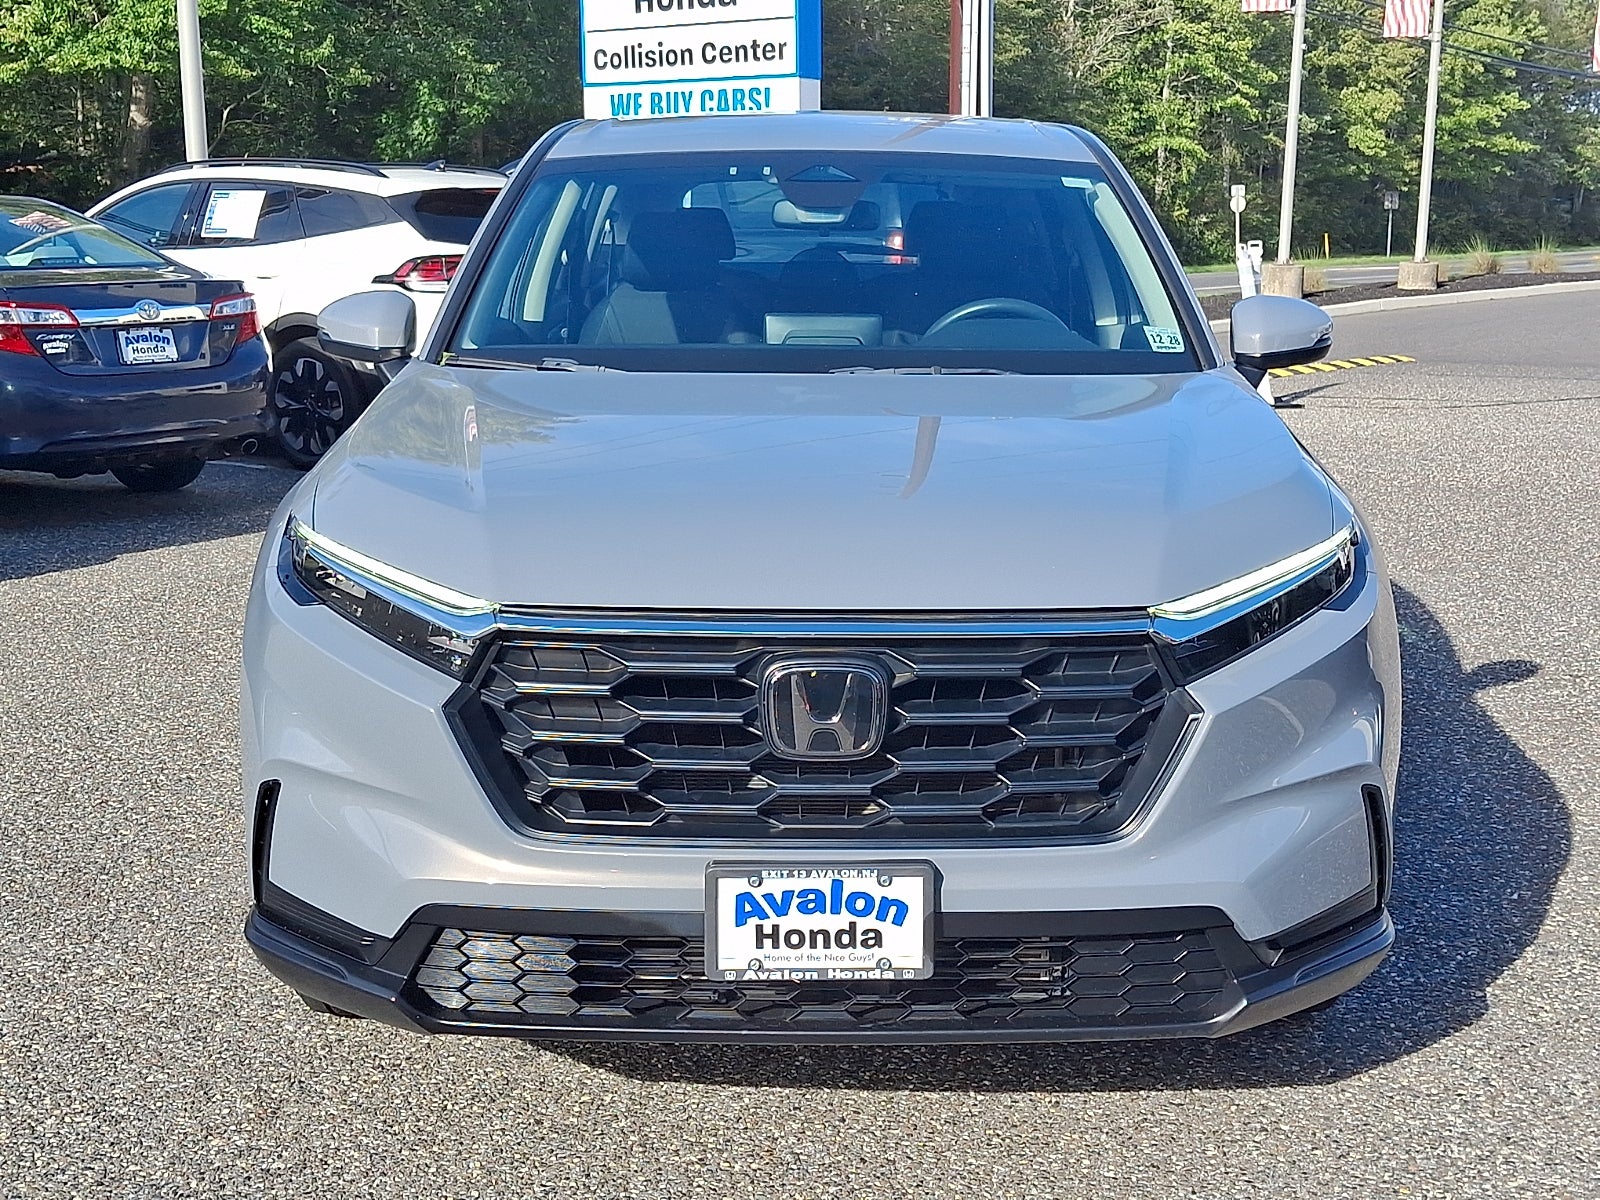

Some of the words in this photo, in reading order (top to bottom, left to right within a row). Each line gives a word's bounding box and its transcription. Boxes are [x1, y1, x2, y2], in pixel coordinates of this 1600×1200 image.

[635, 0, 737, 13] Hon
[594, 41, 694, 70] Collision
[701, 39, 787, 65] Center
[610, 92, 642, 116] WE
[124, 331, 171, 348] Avalon
[1150, 333, 1165, 344] 12
[1167, 335, 1181, 345] 28
[42, 340, 69, 351] Avalon
[131, 344, 166, 355] Honda
[761, 869, 789, 878] EXIT
[793, 869, 807, 878] 13
[735, 879, 909, 927] Avalon
[755, 922, 883, 949] Honda
[763, 953, 791, 962] Home
[794, 953, 803, 962] of
[807, 953, 821, 962] the
[824, 953, 845, 962] Nice
[848, 952, 875, 963] Guys!
[742, 969, 819, 980] Avalon
[828, 968, 895, 980] Honda
